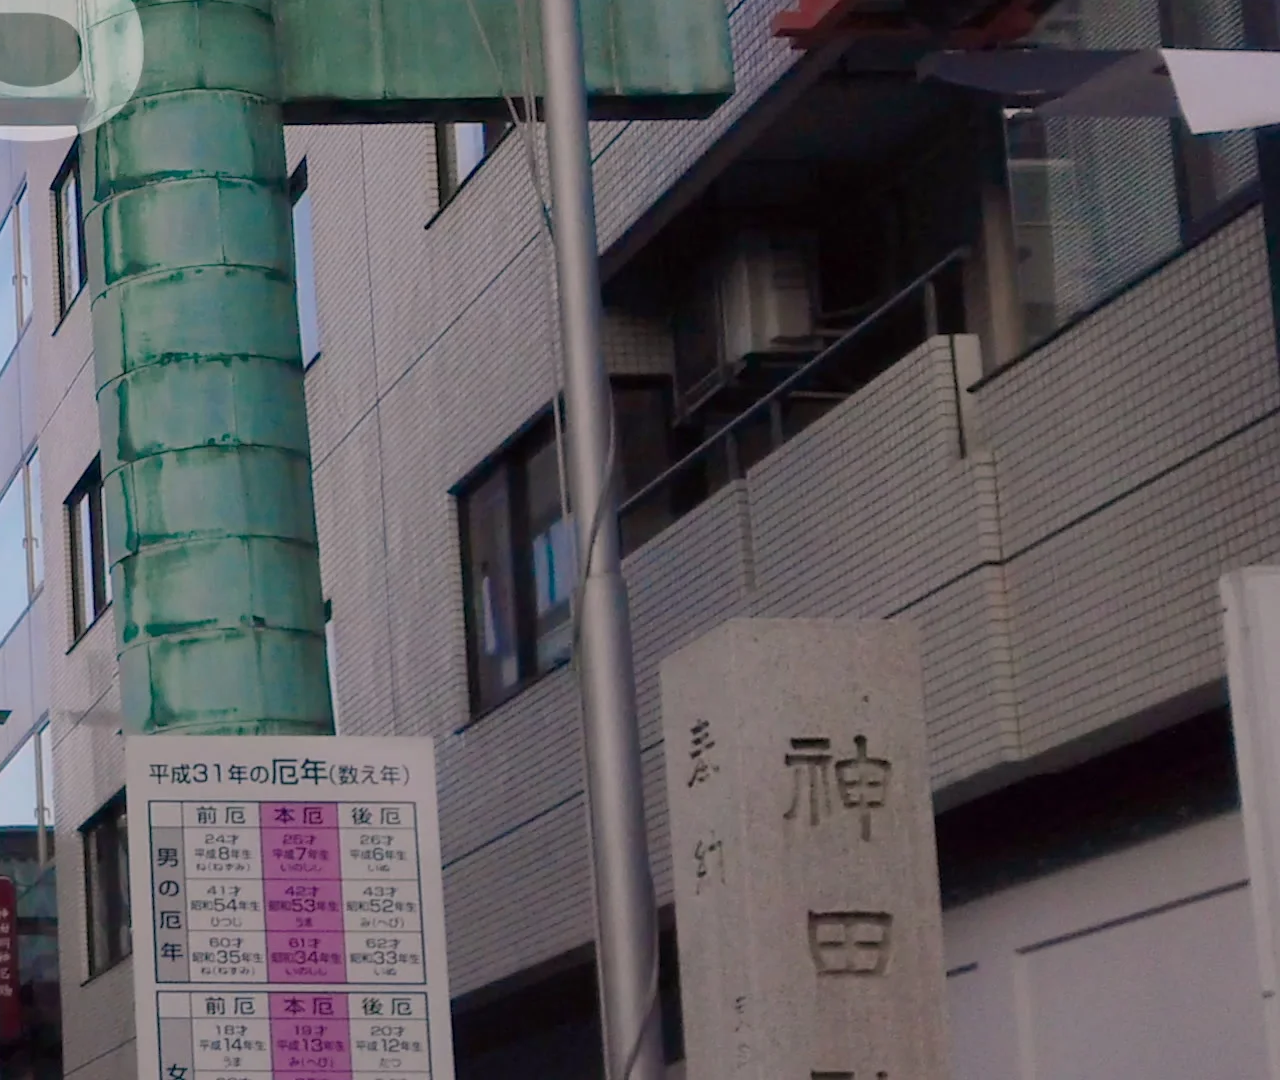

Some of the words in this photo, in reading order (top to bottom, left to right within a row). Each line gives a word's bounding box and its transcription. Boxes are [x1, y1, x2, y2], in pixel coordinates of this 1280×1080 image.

[149, 759, 410, 786] 平成31年の厄年(数え年)
[205, 834, 239, 845] 24才
[360, 834, 394, 845] 26才
[207, 886, 241, 897] 41才
[285, 886, 319, 897] 42才
[363, 886, 397, 897] 43才
[156, 848, 184, 962] 男の厄年
[782, 735, 892, 1080] 神田
[209, 938, 244, 948] 60才
[288, 938, 321, 948] 61才
[365, 938, 401, 948] 62才
[215, 1025, 248, 1036] 18才
[371, 1025, 405, 1036] 20才
